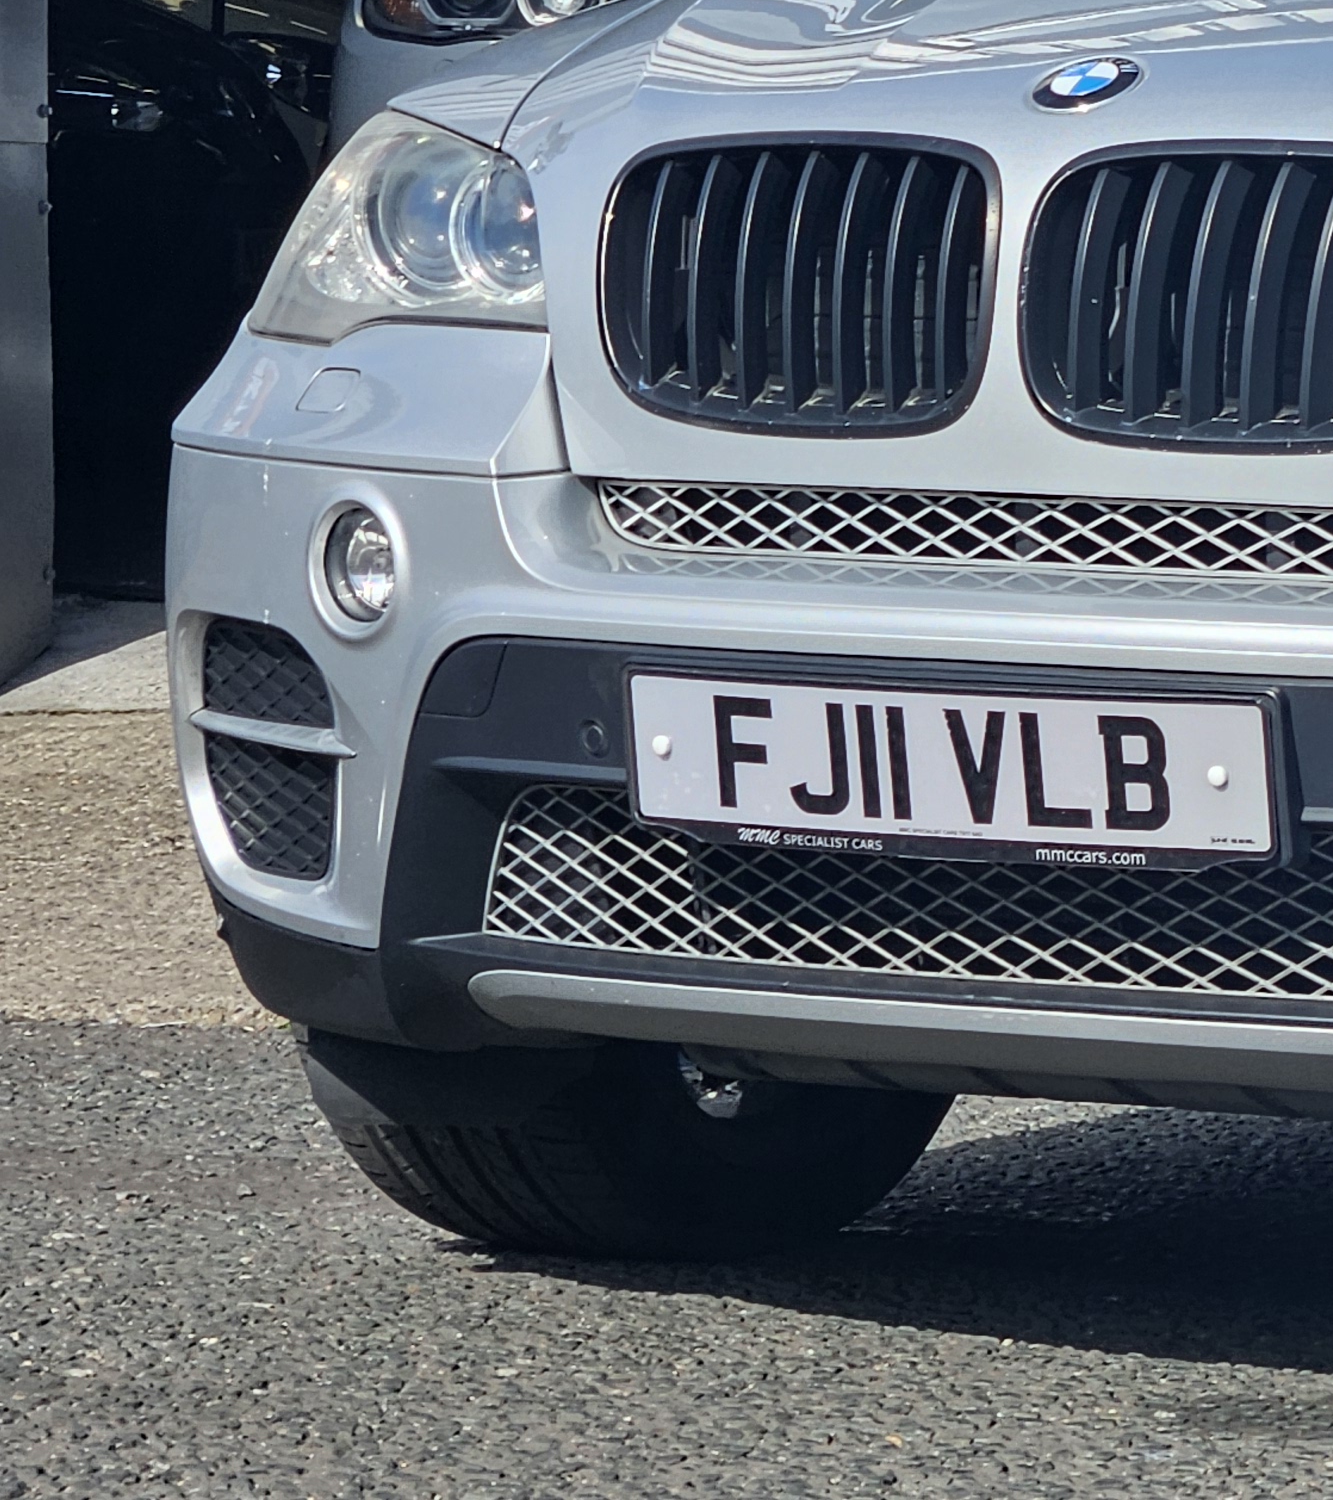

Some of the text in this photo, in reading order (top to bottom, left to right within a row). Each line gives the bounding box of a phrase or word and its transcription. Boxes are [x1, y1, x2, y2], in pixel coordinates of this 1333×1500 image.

[942, 708, 1171, 831] VLB
[737, 827, 883, 851] MMC SPECIALIST CARS
[1035, 848, 1146, 866] mmccars.com
